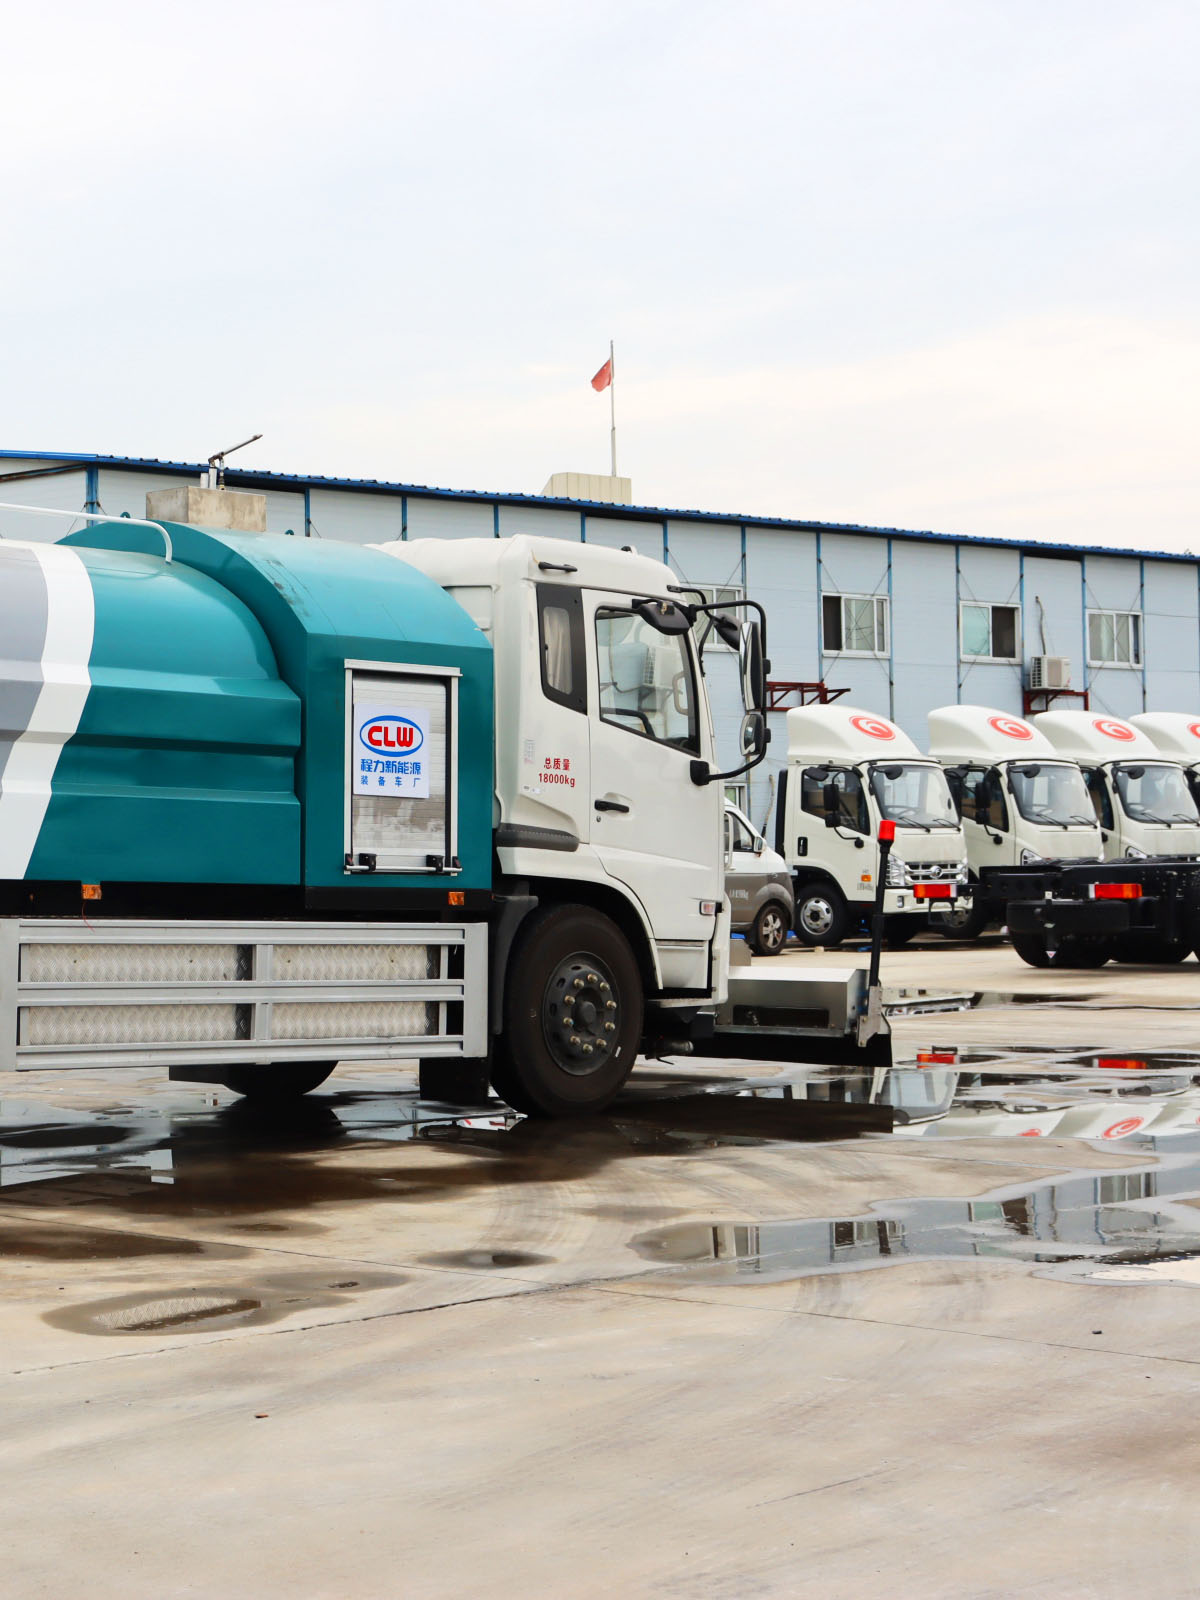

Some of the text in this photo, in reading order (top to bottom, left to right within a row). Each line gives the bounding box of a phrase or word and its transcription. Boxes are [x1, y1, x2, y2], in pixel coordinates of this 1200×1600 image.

[367, 726, 414, 748] CLW
[360, 758, 421, 776] 程力新能源
[543, 757, 571, 771] 总质量
[360, 774, 421, 788] 装备车厂
[538, 772, 576, 788] 18000kg
